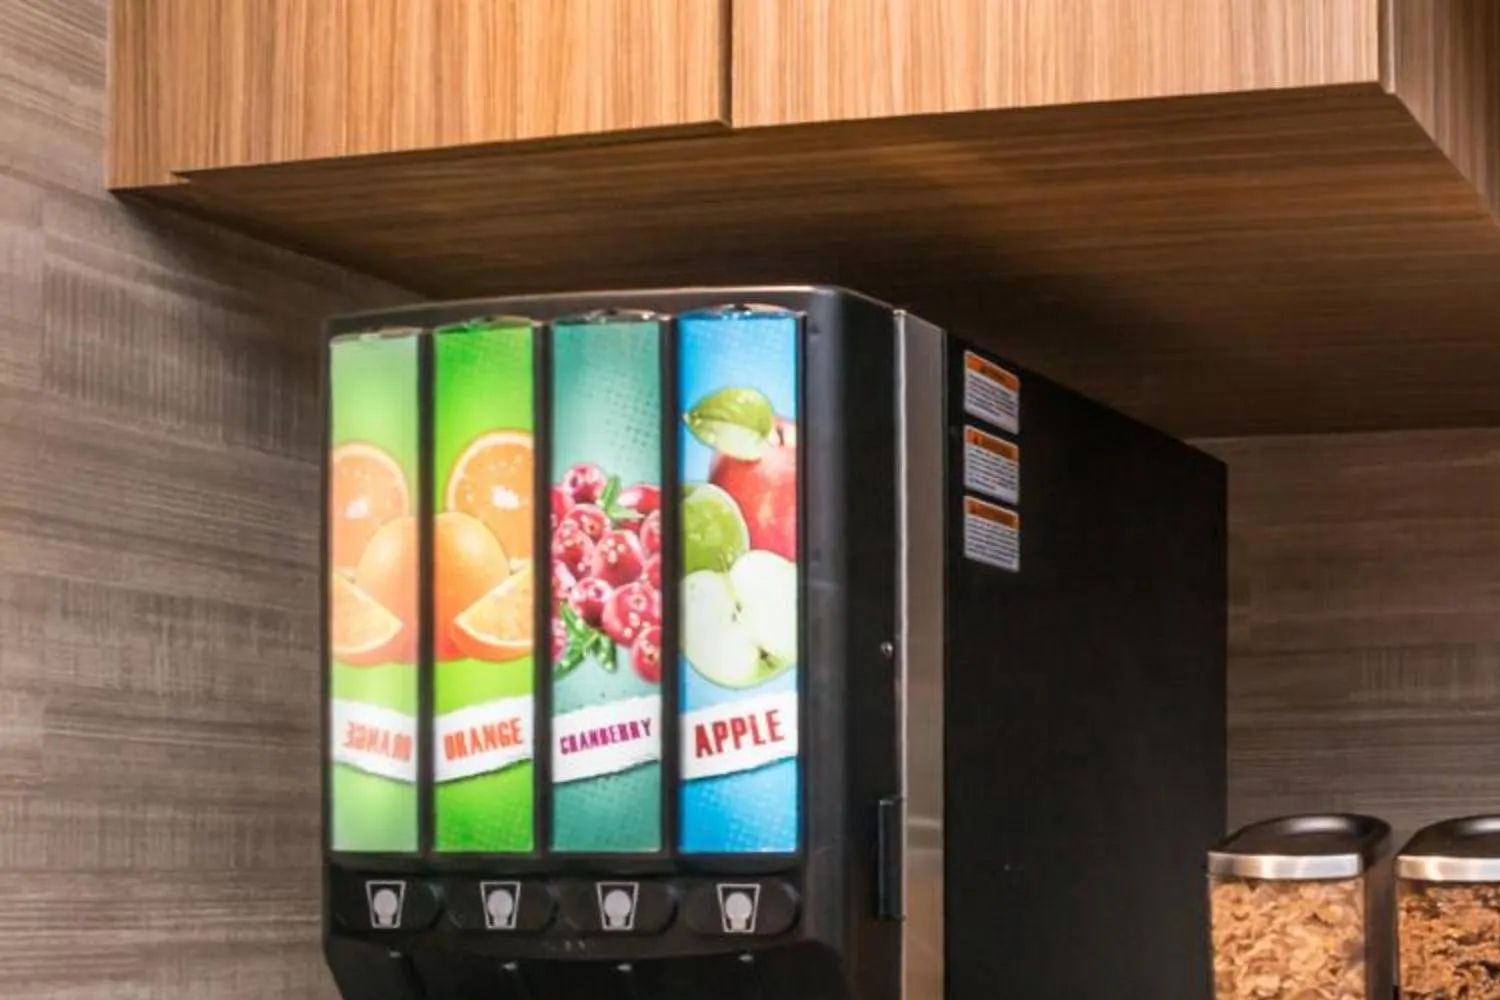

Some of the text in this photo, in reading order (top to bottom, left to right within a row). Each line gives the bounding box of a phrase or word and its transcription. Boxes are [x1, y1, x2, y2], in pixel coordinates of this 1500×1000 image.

[443, 717, 523, 762] ORANGE
[559, 717, 653, 756] CRANBERRY
[694, 709, 786, 758] APPLE
